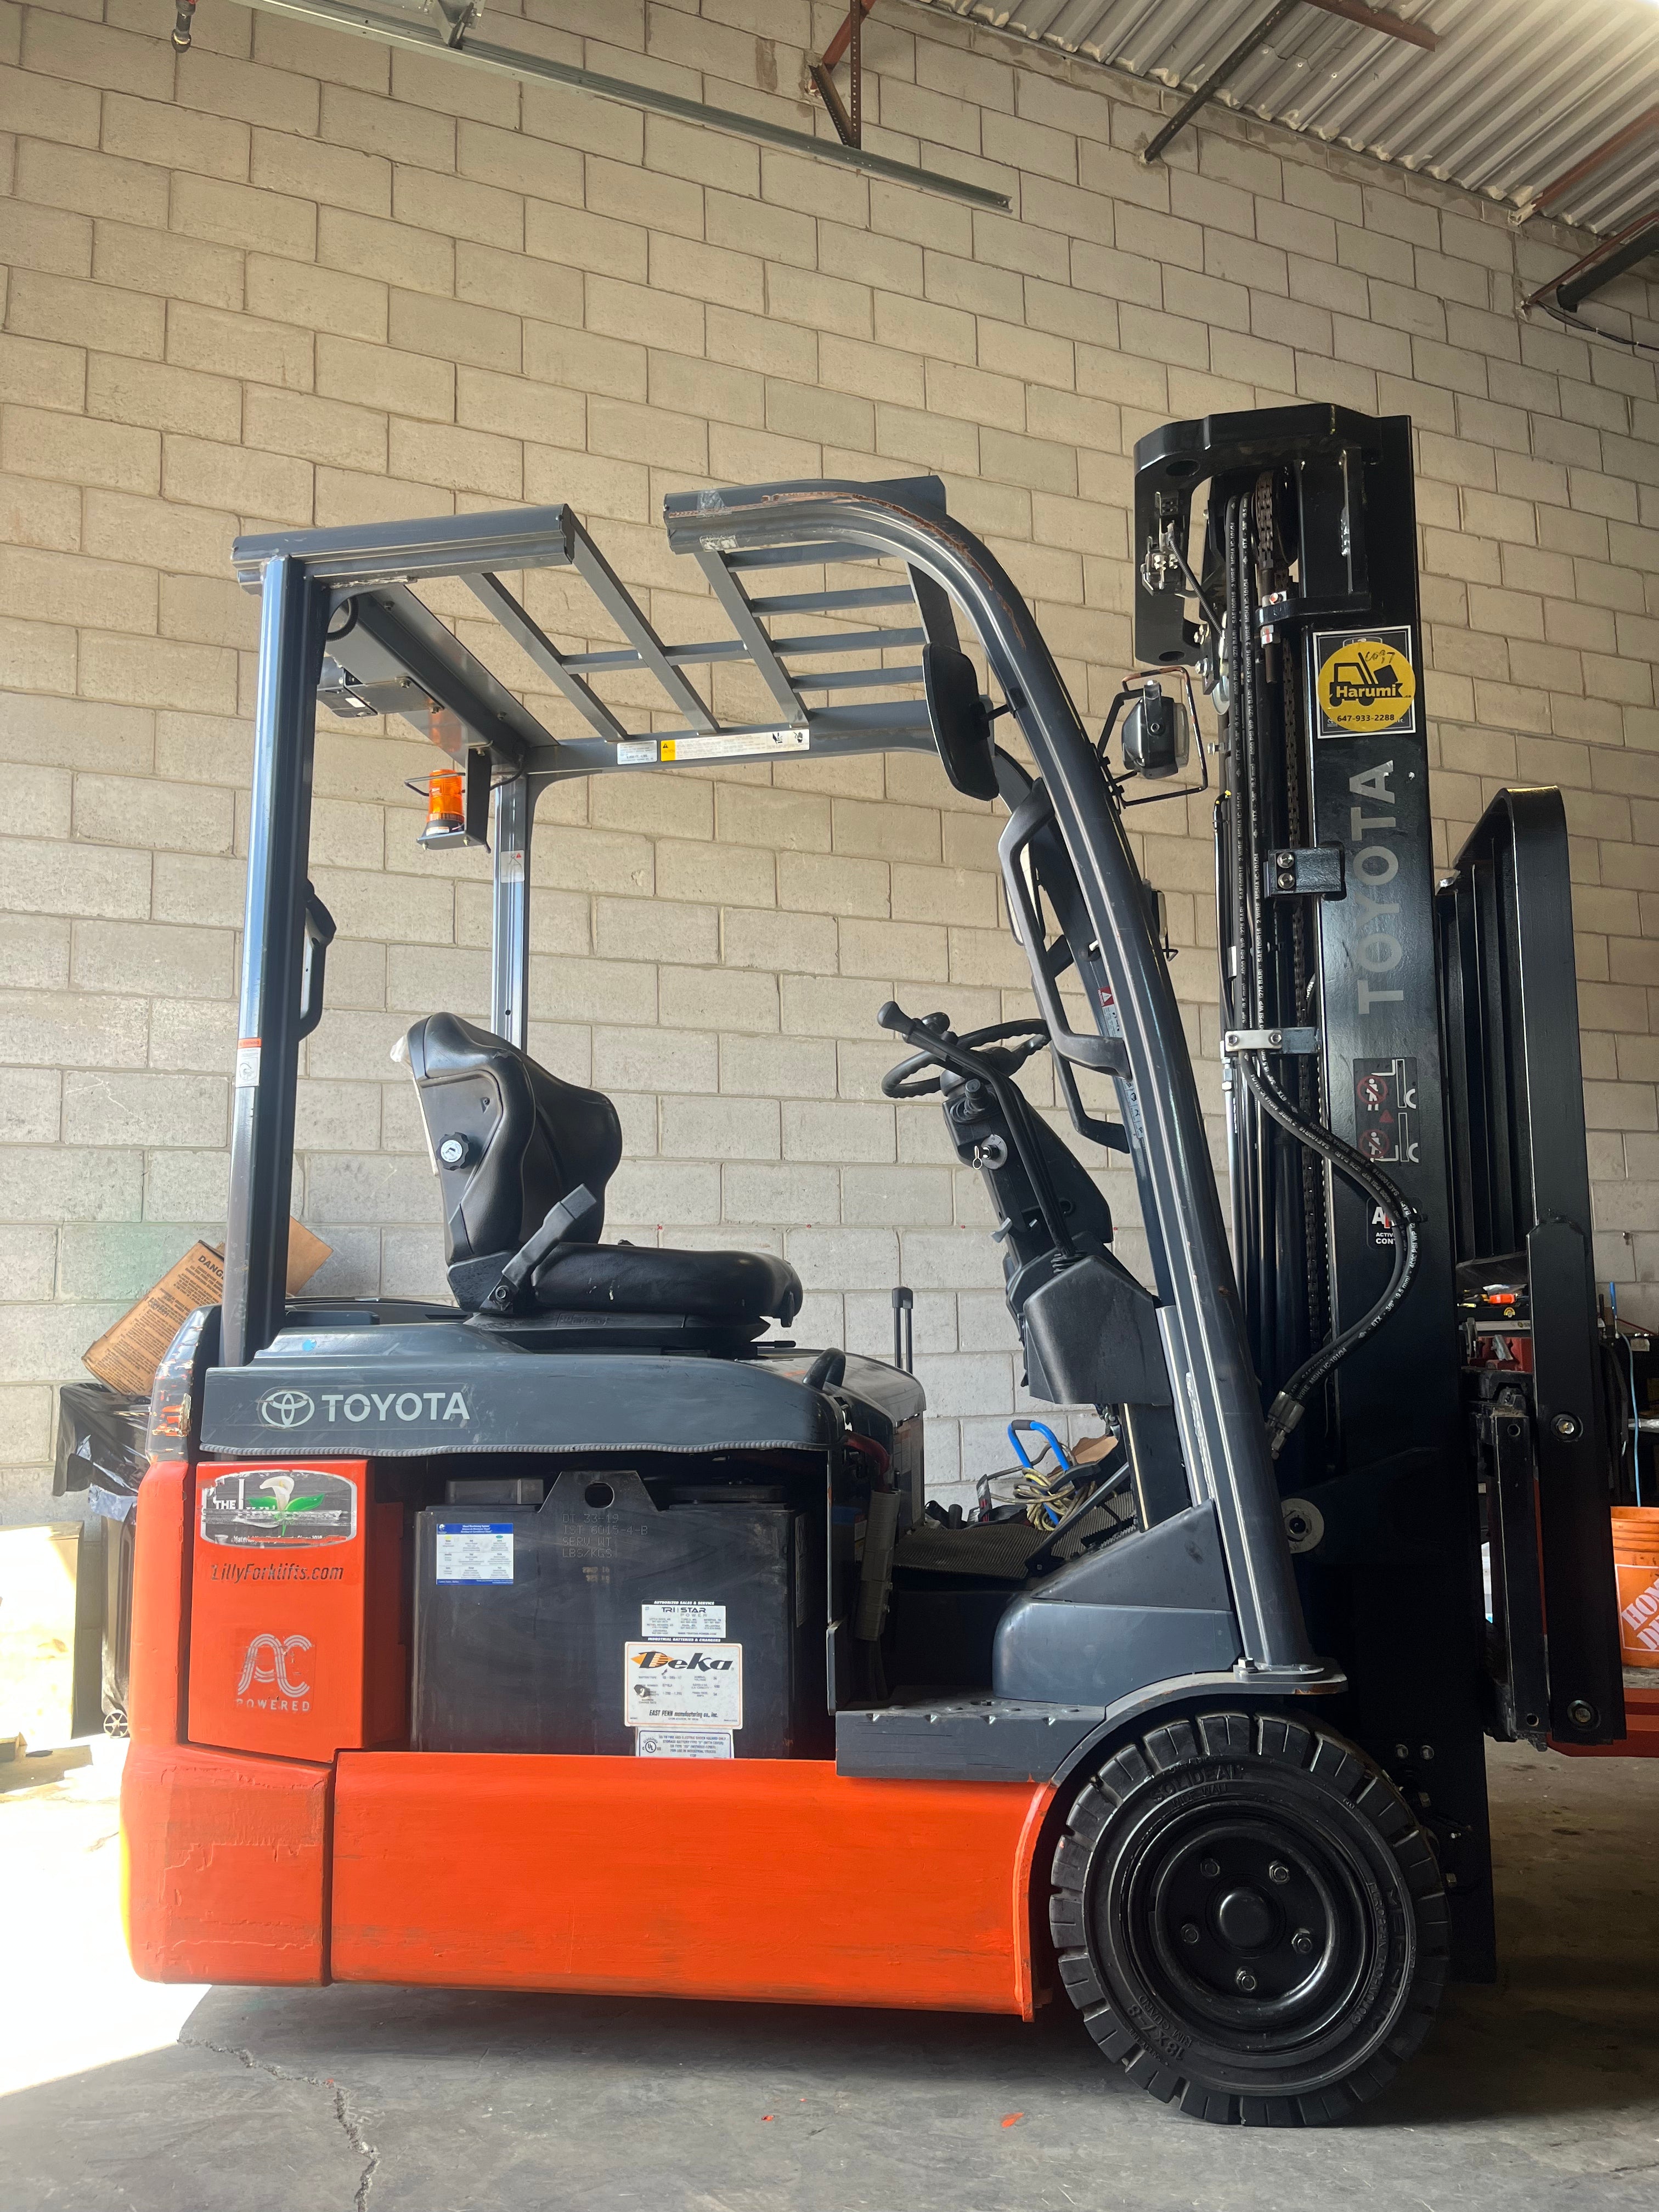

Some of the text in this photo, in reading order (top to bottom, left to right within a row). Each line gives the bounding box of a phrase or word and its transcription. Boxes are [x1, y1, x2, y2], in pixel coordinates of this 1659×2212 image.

[1233, 660, 1238, 669] WP
[1336, 684, 1396, 698] Harumi
[1249, 720, 1254, 730] WP
[1349, 760, 1404, 1014] TOYOTA
[1240, 938, 1245, 947] WP
[1259, 1001, 1264, 1011] WP
[1411, 1231, 1418, 1242] WP
[198, 1255, 224, 1280] DANG
[321, 1392, 470, 1422] TOYOTA
[215, 1500, 236, 1509] THE
[583, 1514, 619, 1523] 33-19
[597, 1537, 612, 1547] WT
[562, 1548, 612, 1558] LBS/KGS
[1621, 1578, 1659, 1630] HOM
[238, 1633, 312, 1697] AC
[639, 1651, 733, 1672] Deka
[236, 1699, 310, 1712] POWERED
